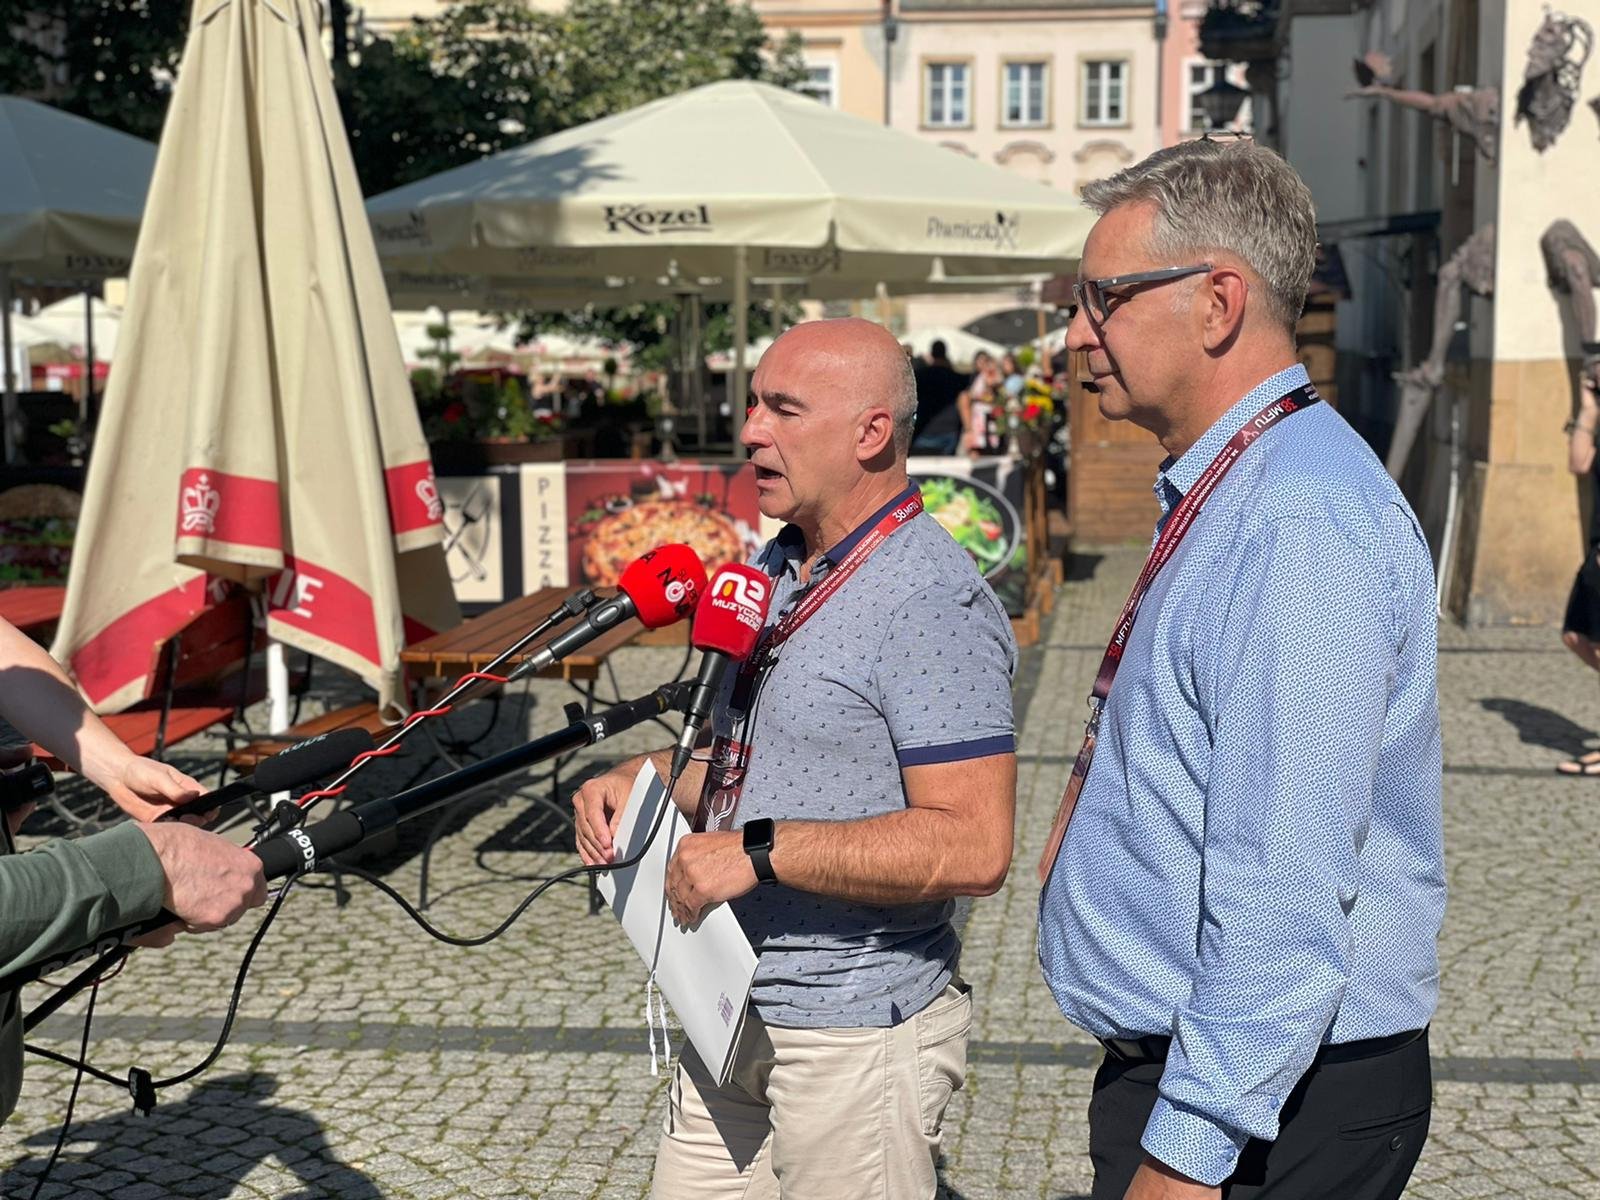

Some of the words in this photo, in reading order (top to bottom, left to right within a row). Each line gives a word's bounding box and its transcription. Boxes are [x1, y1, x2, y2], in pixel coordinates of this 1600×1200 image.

[603, 204, 712, 234] Kozel
[538, 477, 552, 587] PIZZA
[287, 826, 317, 870] RØDE
